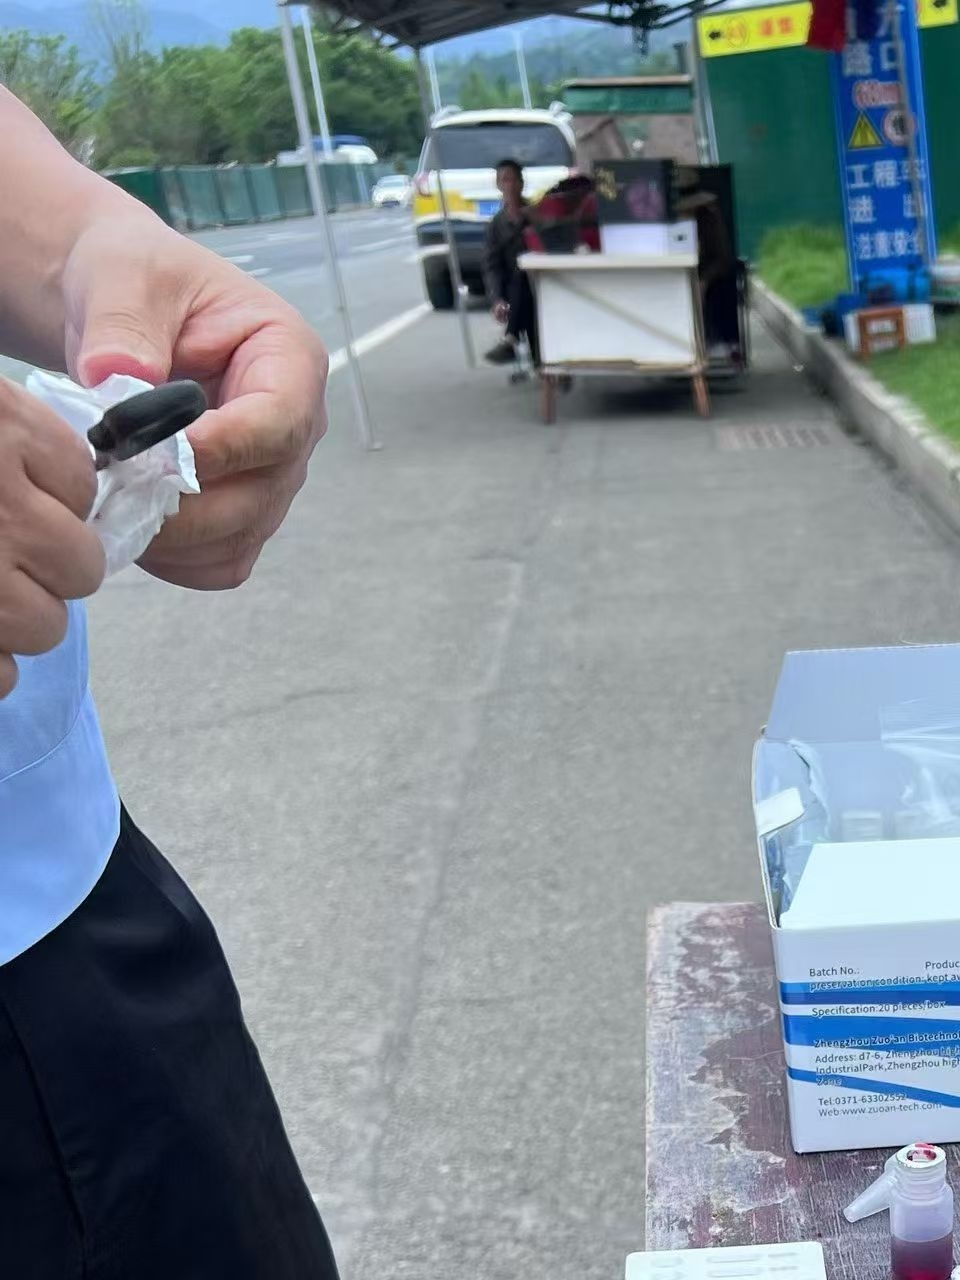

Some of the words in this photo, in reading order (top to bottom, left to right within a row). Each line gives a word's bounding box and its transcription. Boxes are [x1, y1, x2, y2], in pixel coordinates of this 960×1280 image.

[809, 966, 838, 978] Batch
[926, 973, 949, 985] kept
[814, 1038, 869, 1050] Zhengzhou
[815, 1053, 857, 1064] Address:
[885, 1047, 938, 1060] Zhengzhou
